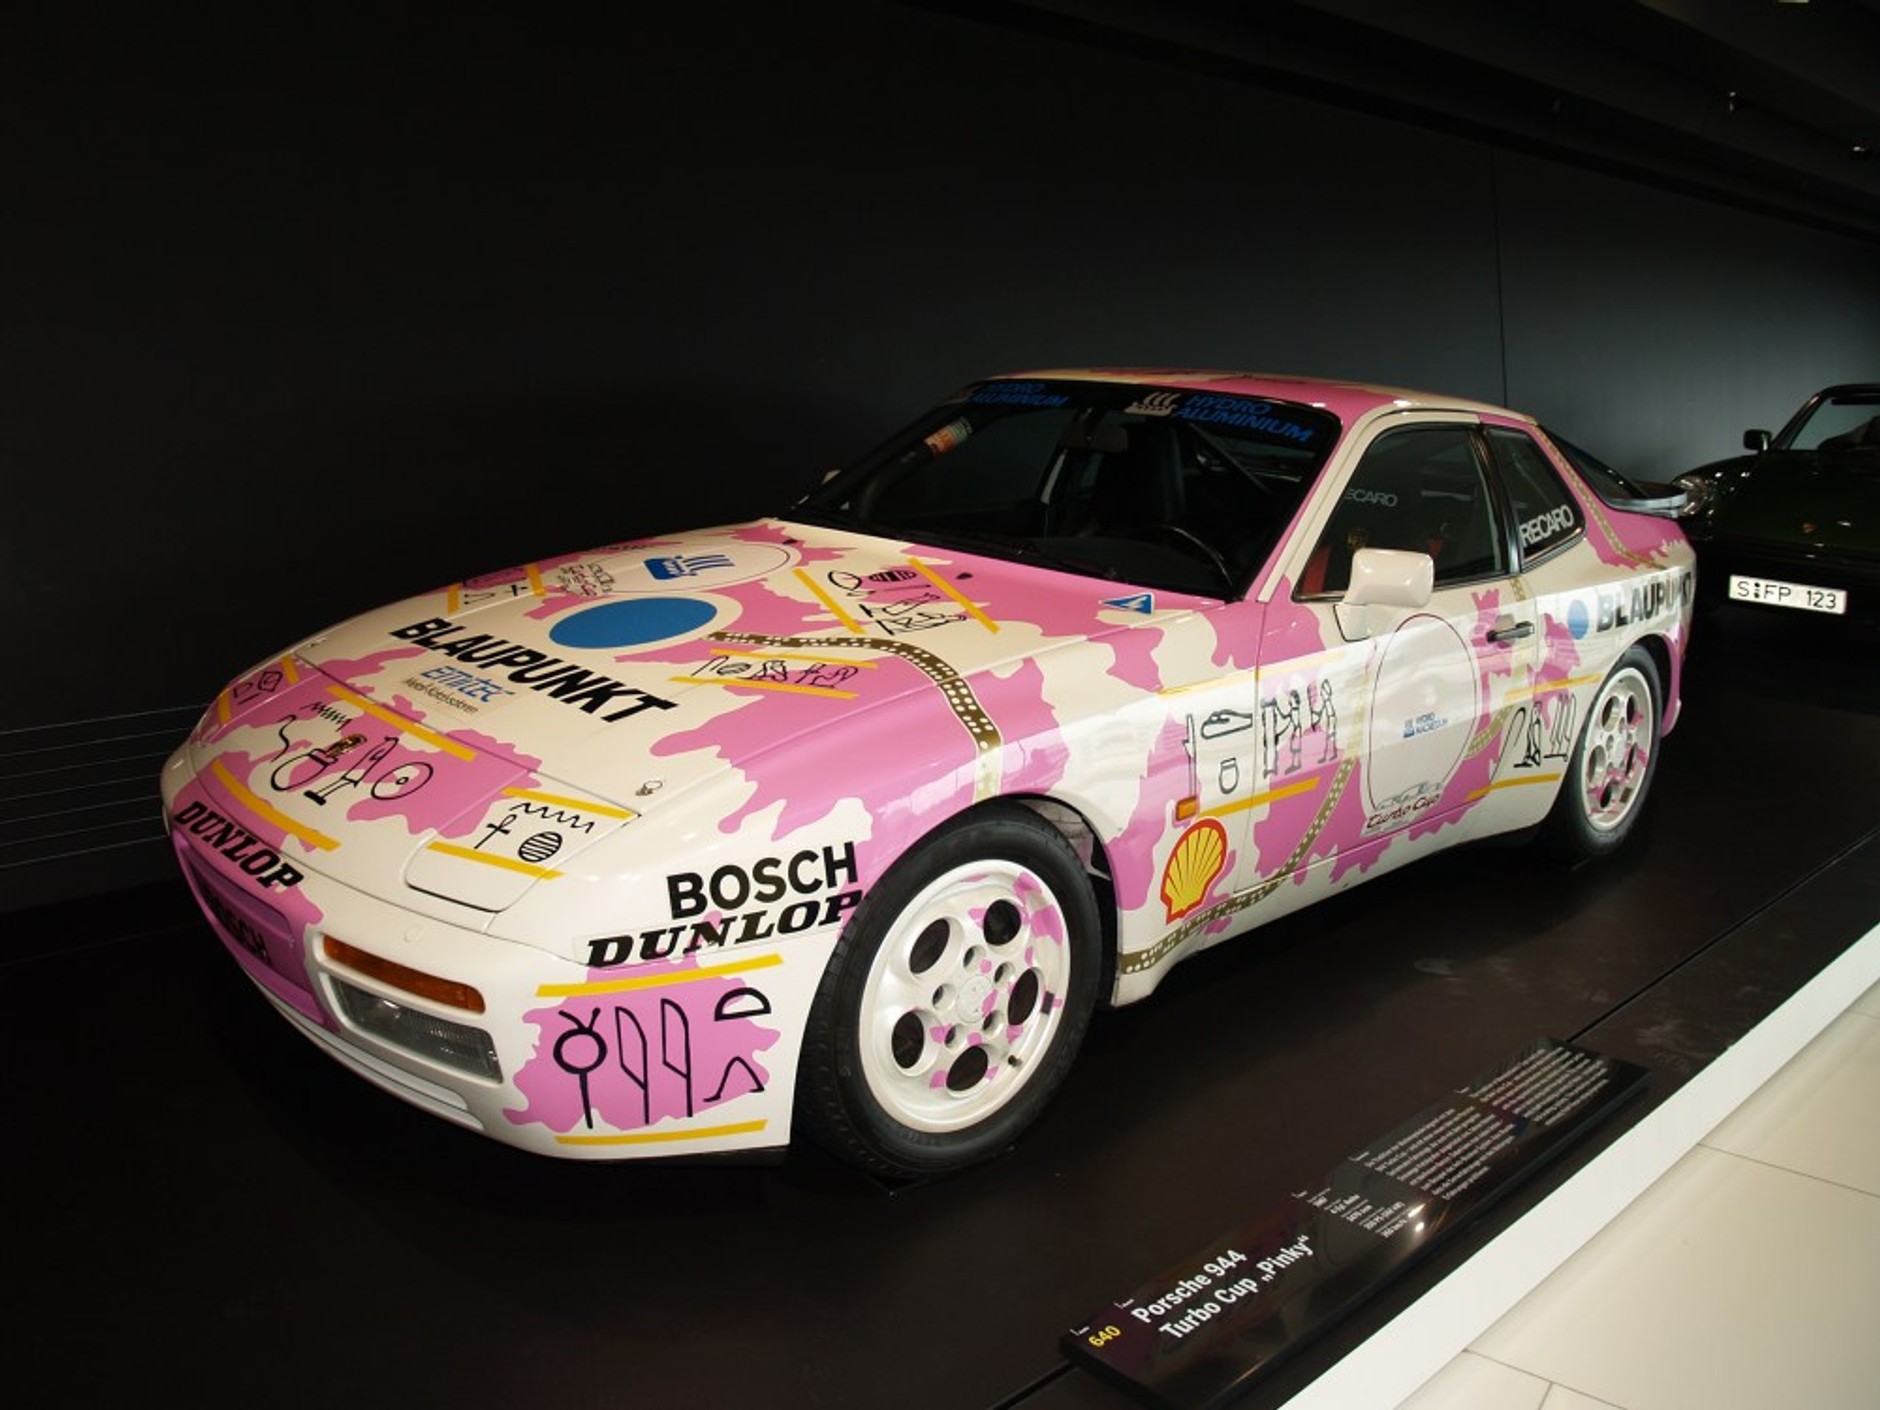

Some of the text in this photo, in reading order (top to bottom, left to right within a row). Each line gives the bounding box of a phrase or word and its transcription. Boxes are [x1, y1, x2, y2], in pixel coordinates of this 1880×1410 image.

[1172, 407, 1316, 442] ALUMINIUM
[1187, 393, 1273, 415] HYDRO
[1518, 504, 1574, 548] RECARO
[1806, 589, 1837, 610] 123
[388, 616, 680, 723] BLAUPUNKT
[173, 800, 305, 889] DUNLOP
[666, 840, 859, 920] BOSCH
[586, 889, 863, 968] DUNLOP
[1130, 1249, 1248, 1324] Porsche 944
[1158, 1301, 1222, 1339] Turbo
[1213, 1276, 1259, 1304] Cup
[1087, 1324, 1123, 1348] 640
